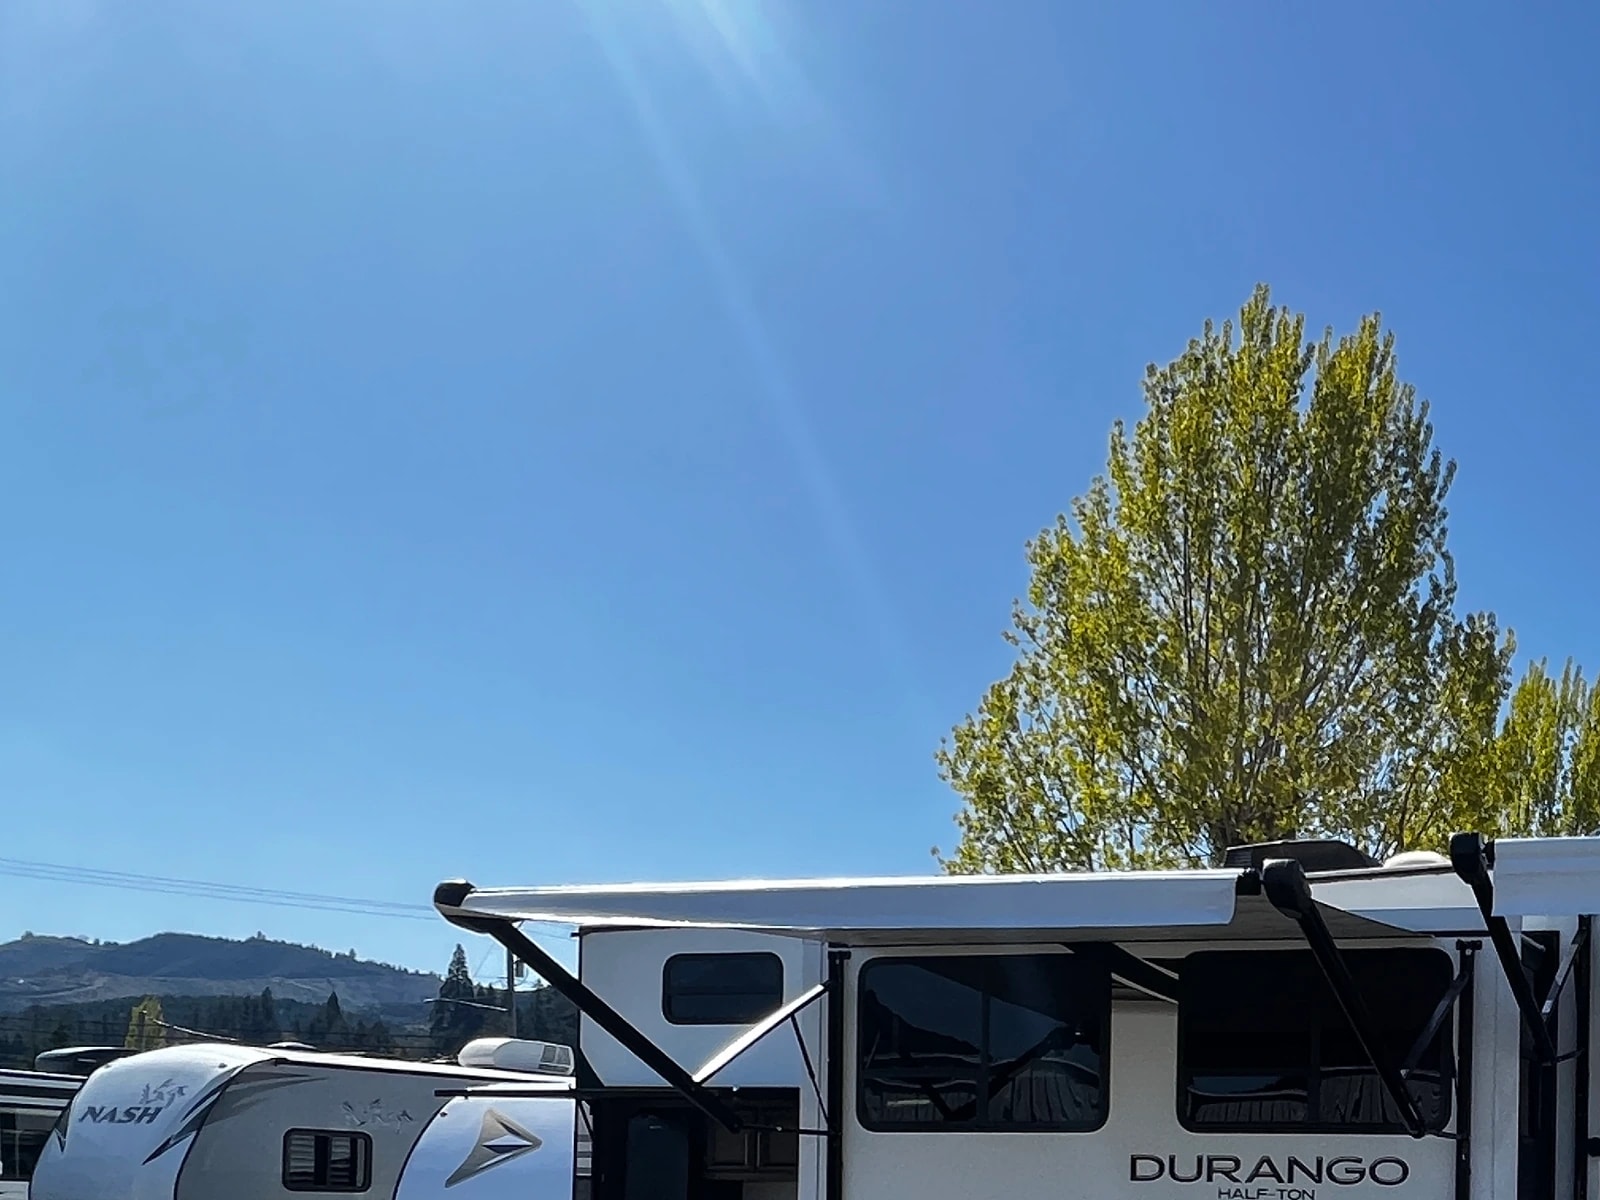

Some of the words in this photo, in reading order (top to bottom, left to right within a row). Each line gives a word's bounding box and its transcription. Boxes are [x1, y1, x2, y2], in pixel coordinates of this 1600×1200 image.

[78, 1106, 164, 1124] NASH
[1129, 1153, 1410, 1186] DURANGO
[1217, 1187, 1316, 1200] HALF-TON
